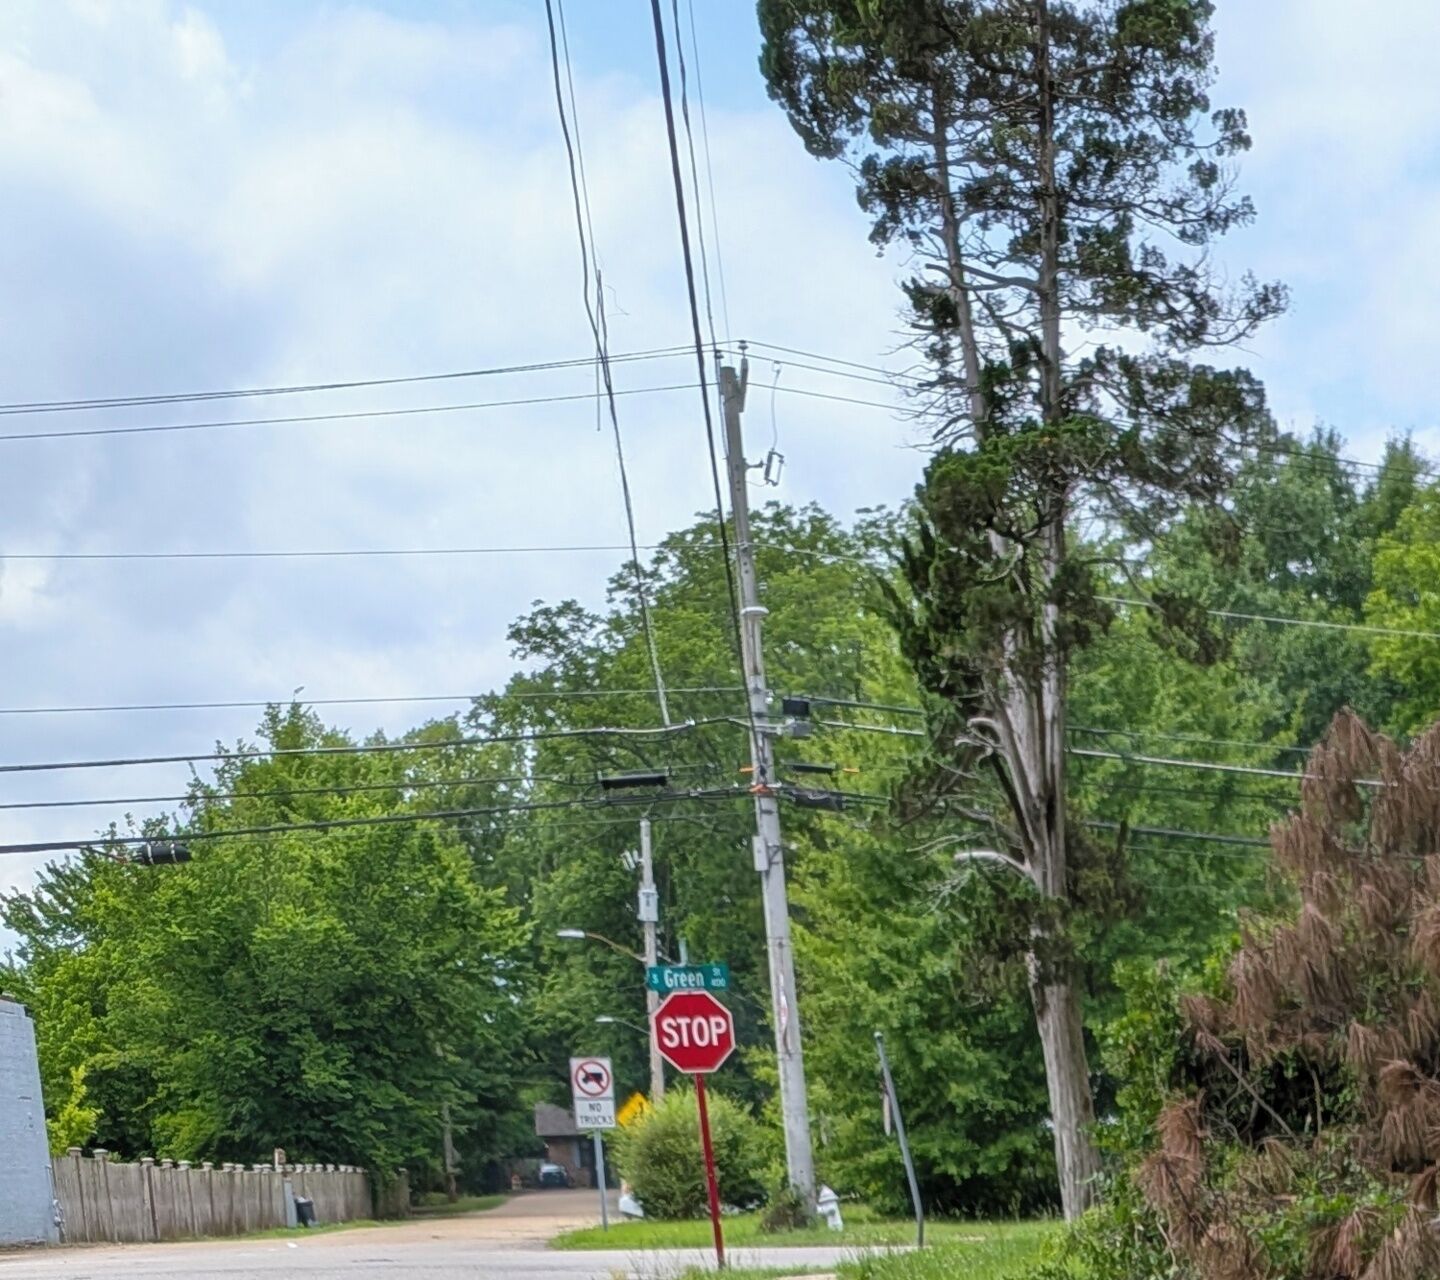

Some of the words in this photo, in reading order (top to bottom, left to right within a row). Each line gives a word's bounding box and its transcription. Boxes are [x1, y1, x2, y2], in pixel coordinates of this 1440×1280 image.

[664, 969, 705, 988] Green
[661, 1016, 727, 1048] STOP
[588, 1102, 602, 1112] NO
[579, 1115, 614, 1125] TRUCKS
